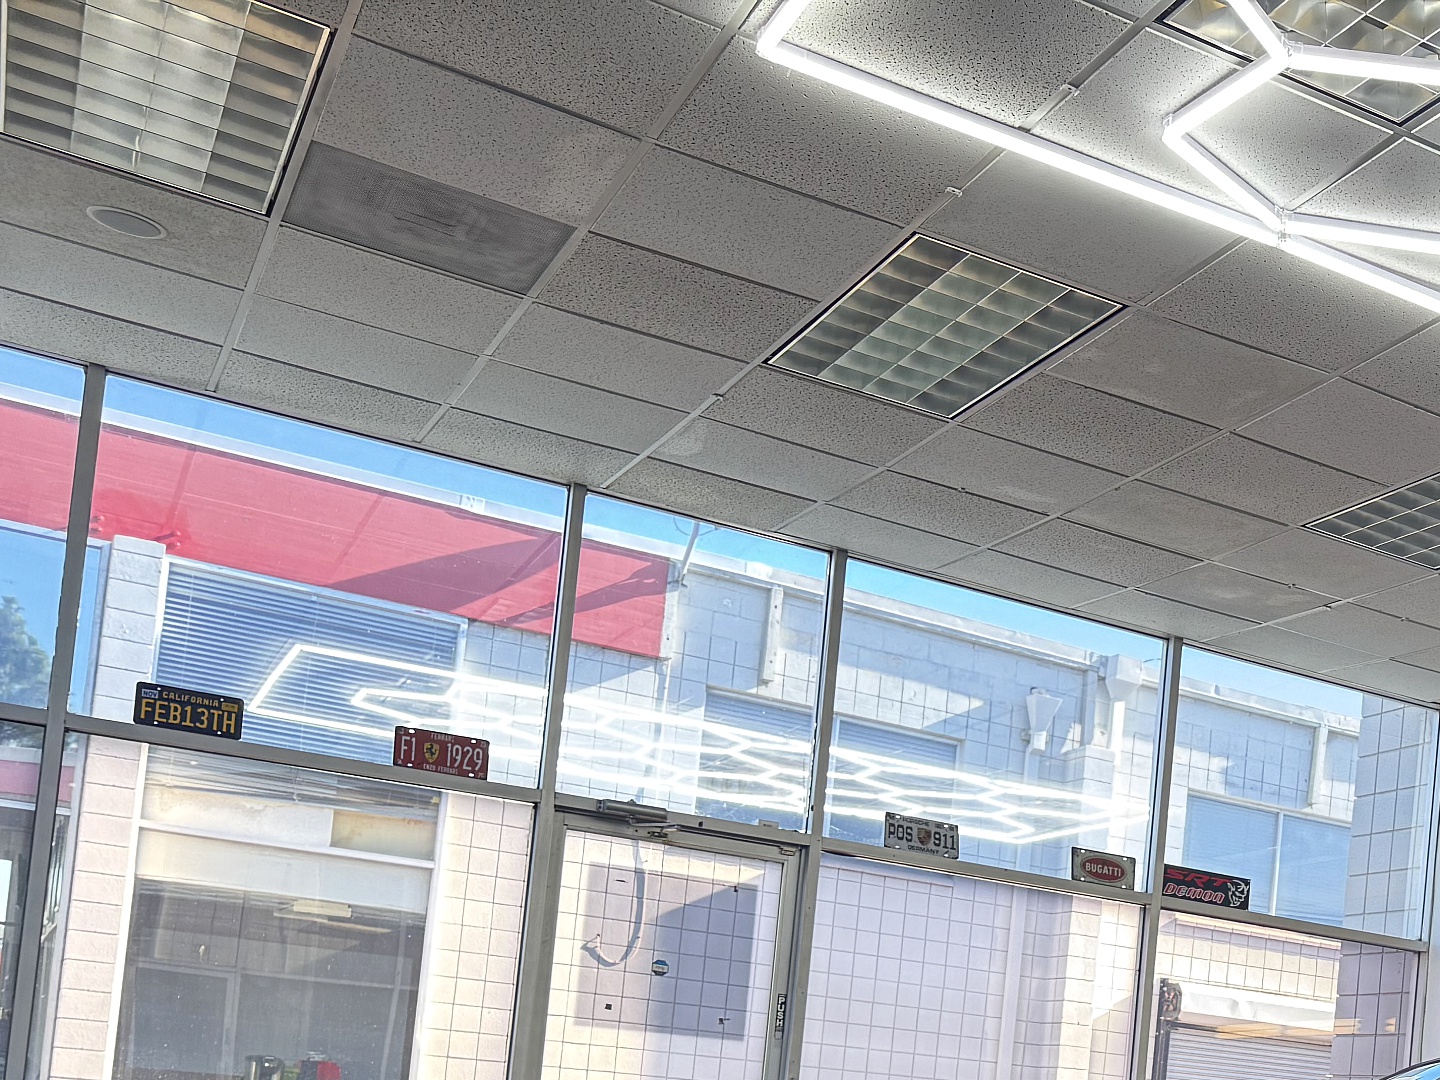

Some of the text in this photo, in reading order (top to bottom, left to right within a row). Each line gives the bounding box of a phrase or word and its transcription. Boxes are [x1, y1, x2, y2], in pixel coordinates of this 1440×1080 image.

[143, 690, 158, 698] NOV
[162, 691, 219, 707] CALIFORNIA
[140, 698, 236, 734] FEB13TH
[400, 735, 483, 771] F1 1929
[888, 822, 913, 842] POS
[933, 831, 956, 850] 911
[907, 844, 940, 855] GERMANY
[1085, 862, 1122, 877] BUGATTI
[1164, 868, 1232, 888] SRT
[776, 996, 786, 1027] PUSH
